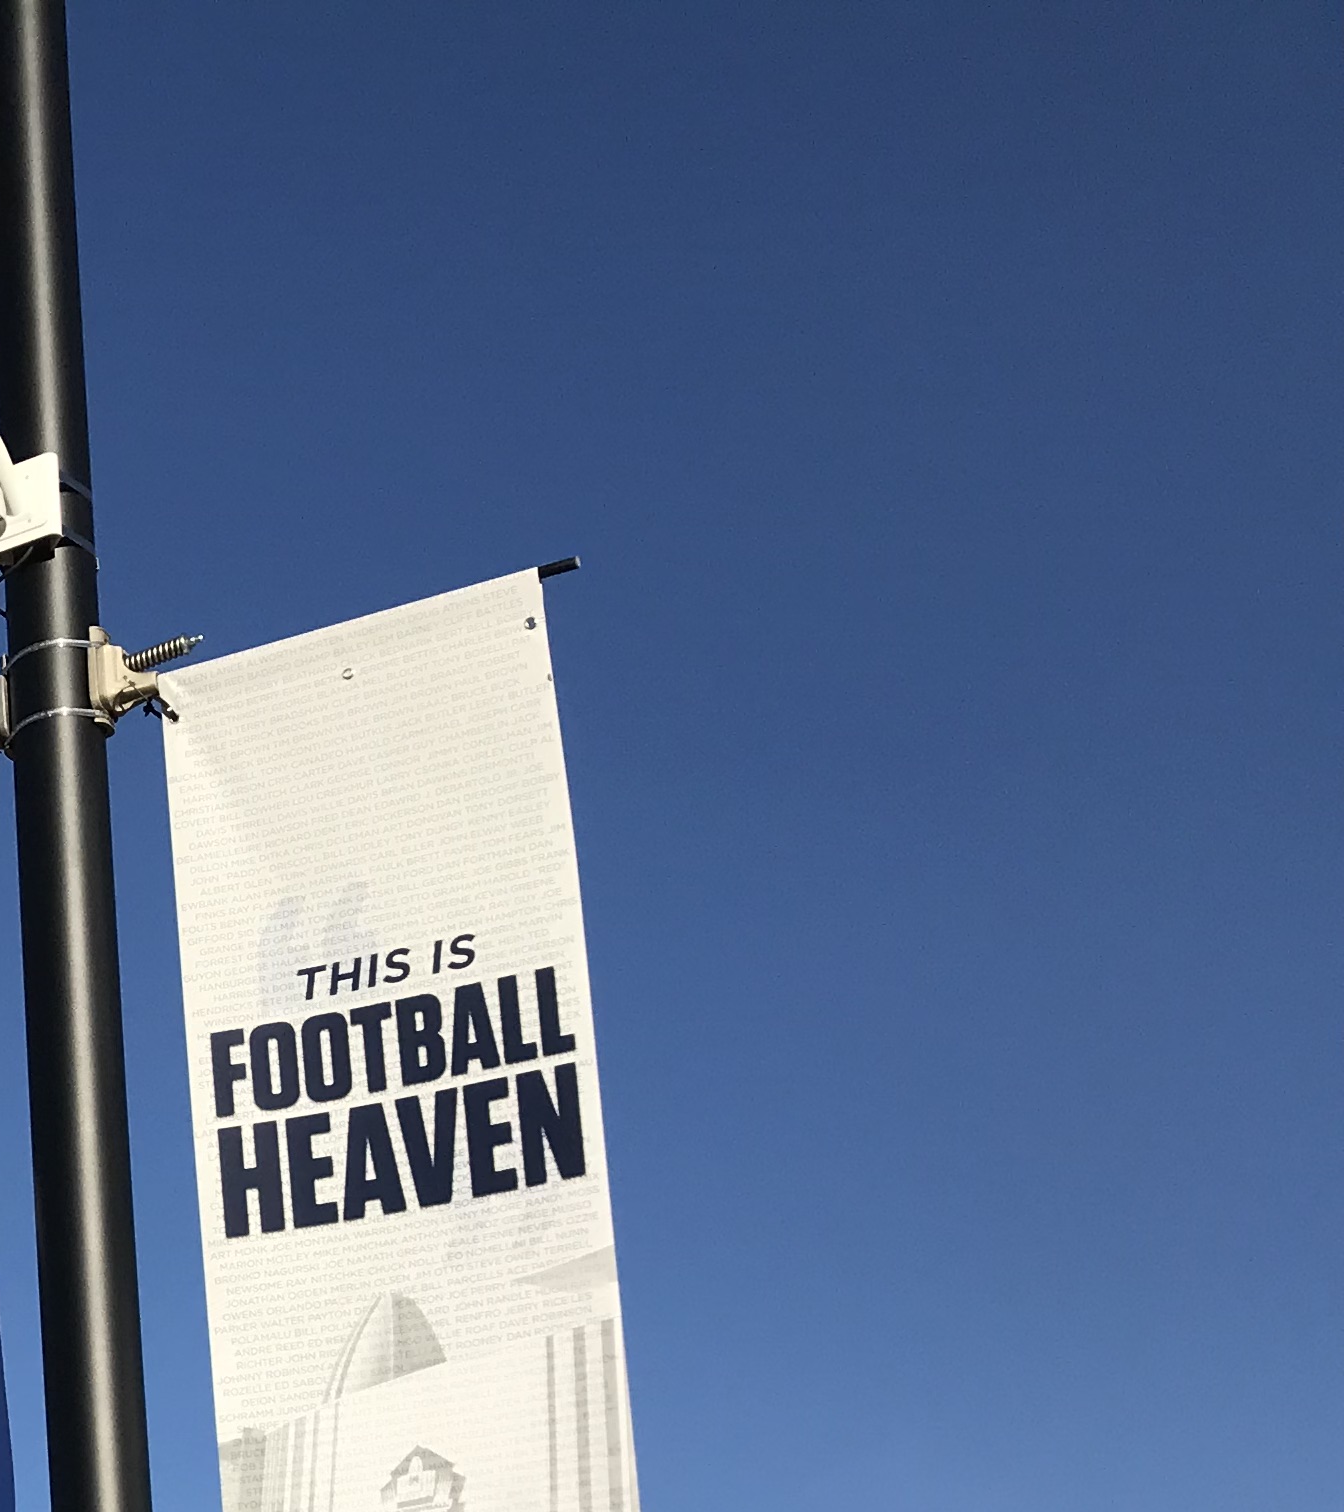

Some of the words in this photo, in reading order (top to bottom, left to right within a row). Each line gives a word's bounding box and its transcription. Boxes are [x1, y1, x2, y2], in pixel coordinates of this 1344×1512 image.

[211, 966, 576, 1118] FOOTBALL
[297, 947, 410, 1000] THIS
[432, 933, 475, 973] IS
[217, 1062, 585, 1238] HEAVEN
